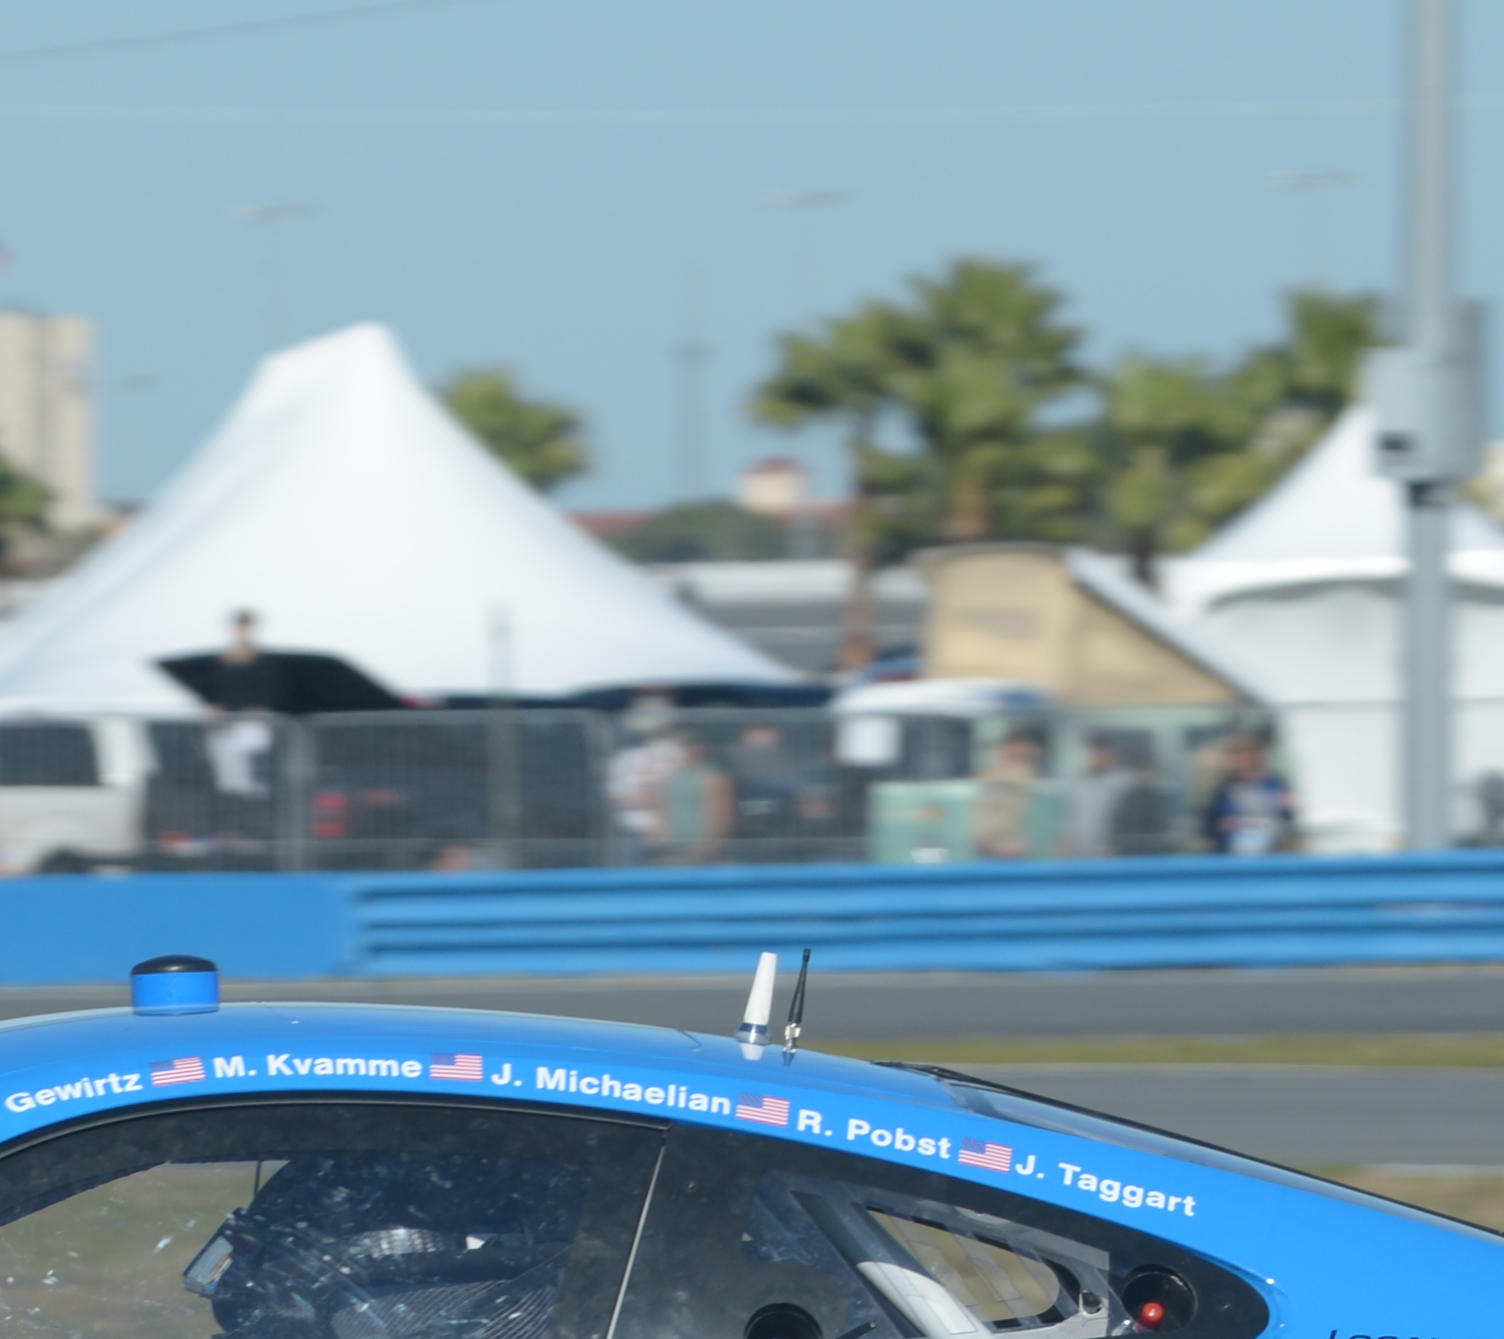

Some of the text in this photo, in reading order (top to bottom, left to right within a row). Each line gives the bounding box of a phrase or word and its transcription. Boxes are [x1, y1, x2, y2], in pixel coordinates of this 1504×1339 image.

[4, 1069, 143, 1114] Gewirtz
[212, 1054, 423, 1079] M. Kvamme
[490, 1063, 732, 1115] J. Michaelian
[796, 1110, 952, 1160] R. Pobst
[1014, 1151, 1196, 1219] J. Taggart
